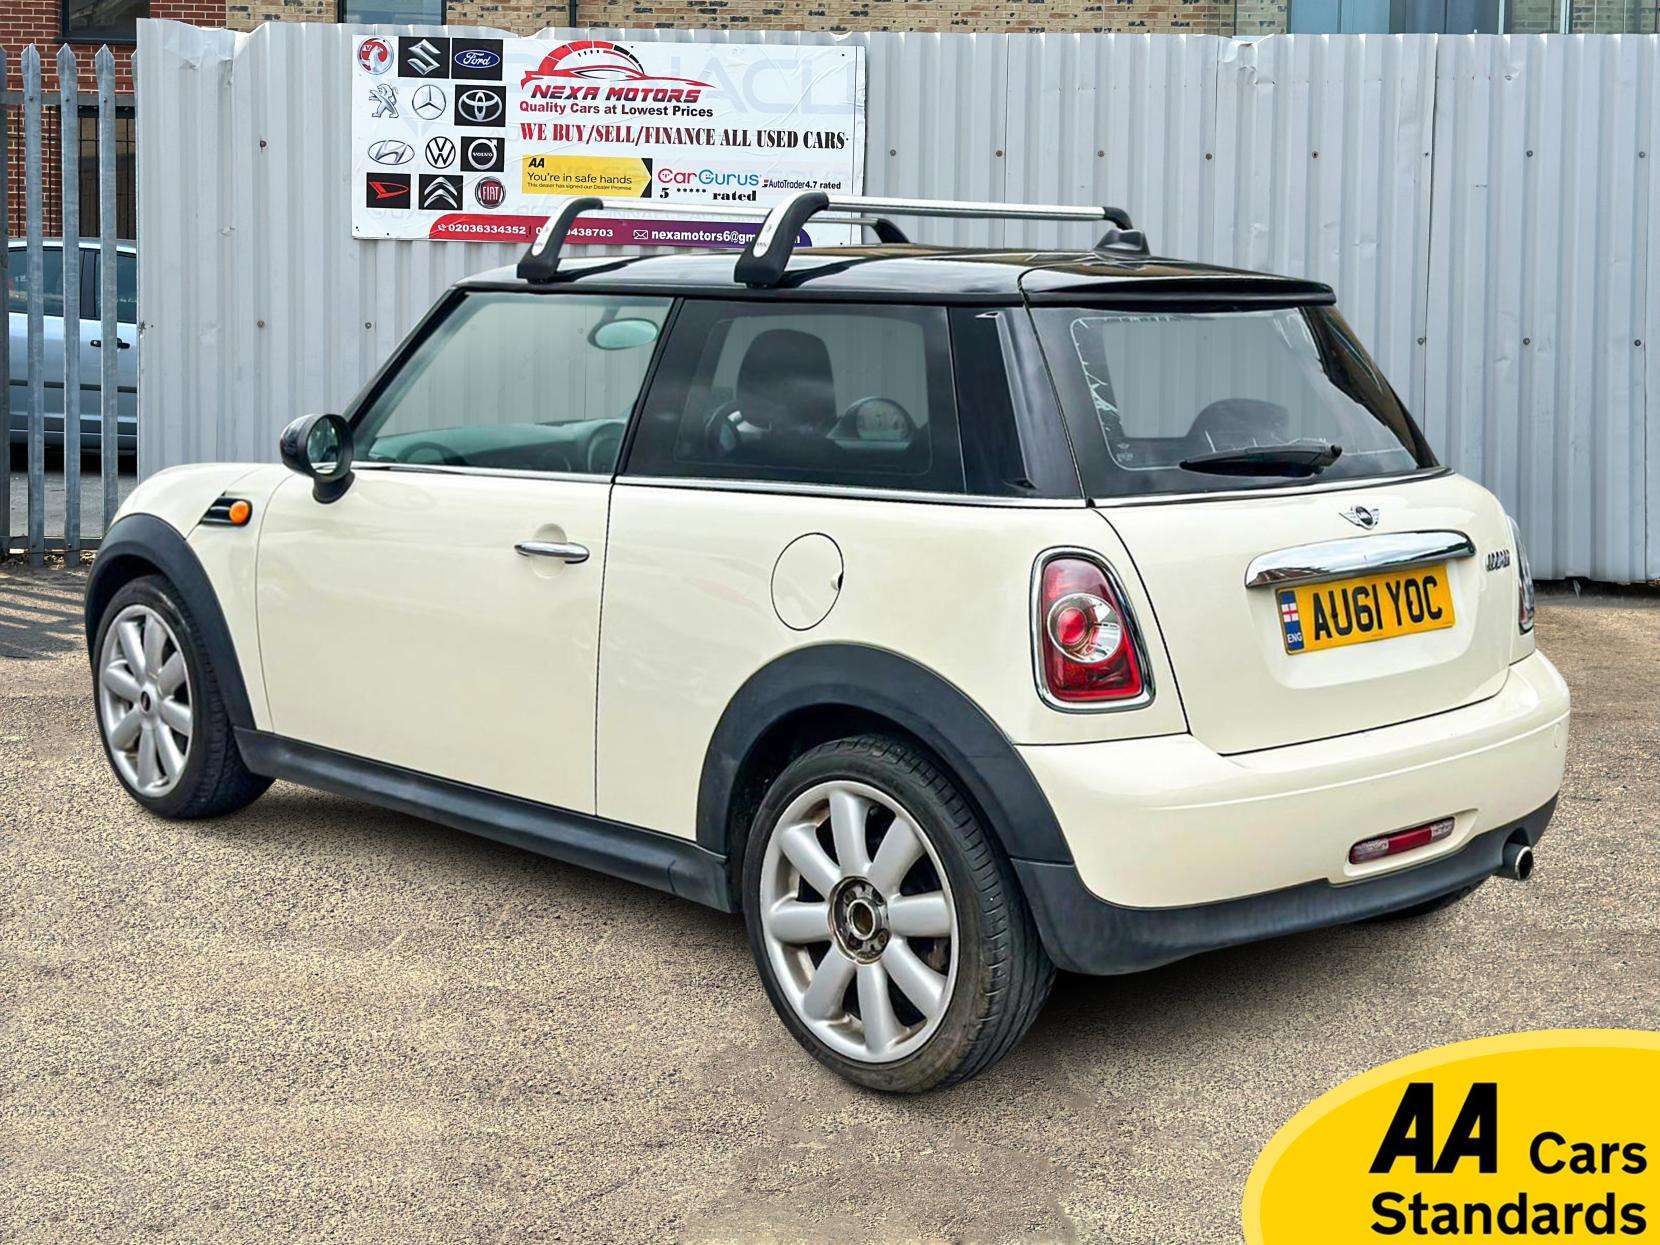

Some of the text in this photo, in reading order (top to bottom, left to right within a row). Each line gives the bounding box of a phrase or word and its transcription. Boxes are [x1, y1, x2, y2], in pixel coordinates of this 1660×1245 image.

[463, 52, 491, 65] Ford
[531, 84, 702, 103] NEXA MOTORS
[520, 101, 713, 117] Quality Cars at Lowest Prices
[520, 123, 845, 149] WE BUY/SELL/FINANCE ALL USED CARS
[528, 157, 545, 168] AA
[528, 172, 632, 184] You're in safe hands
[657, 168, 759, 186] CarGurus
[819, 181, 841, 190] rated
[482, 186, 499, 200] FIAT
[660, 187, 757, 201] 5 rated
[448, 225, 613, 237] 02036334352 0438703
[1312, 575, 1443, 641] AU61 YOC
[1286, 631, 1303, 643] ENG
